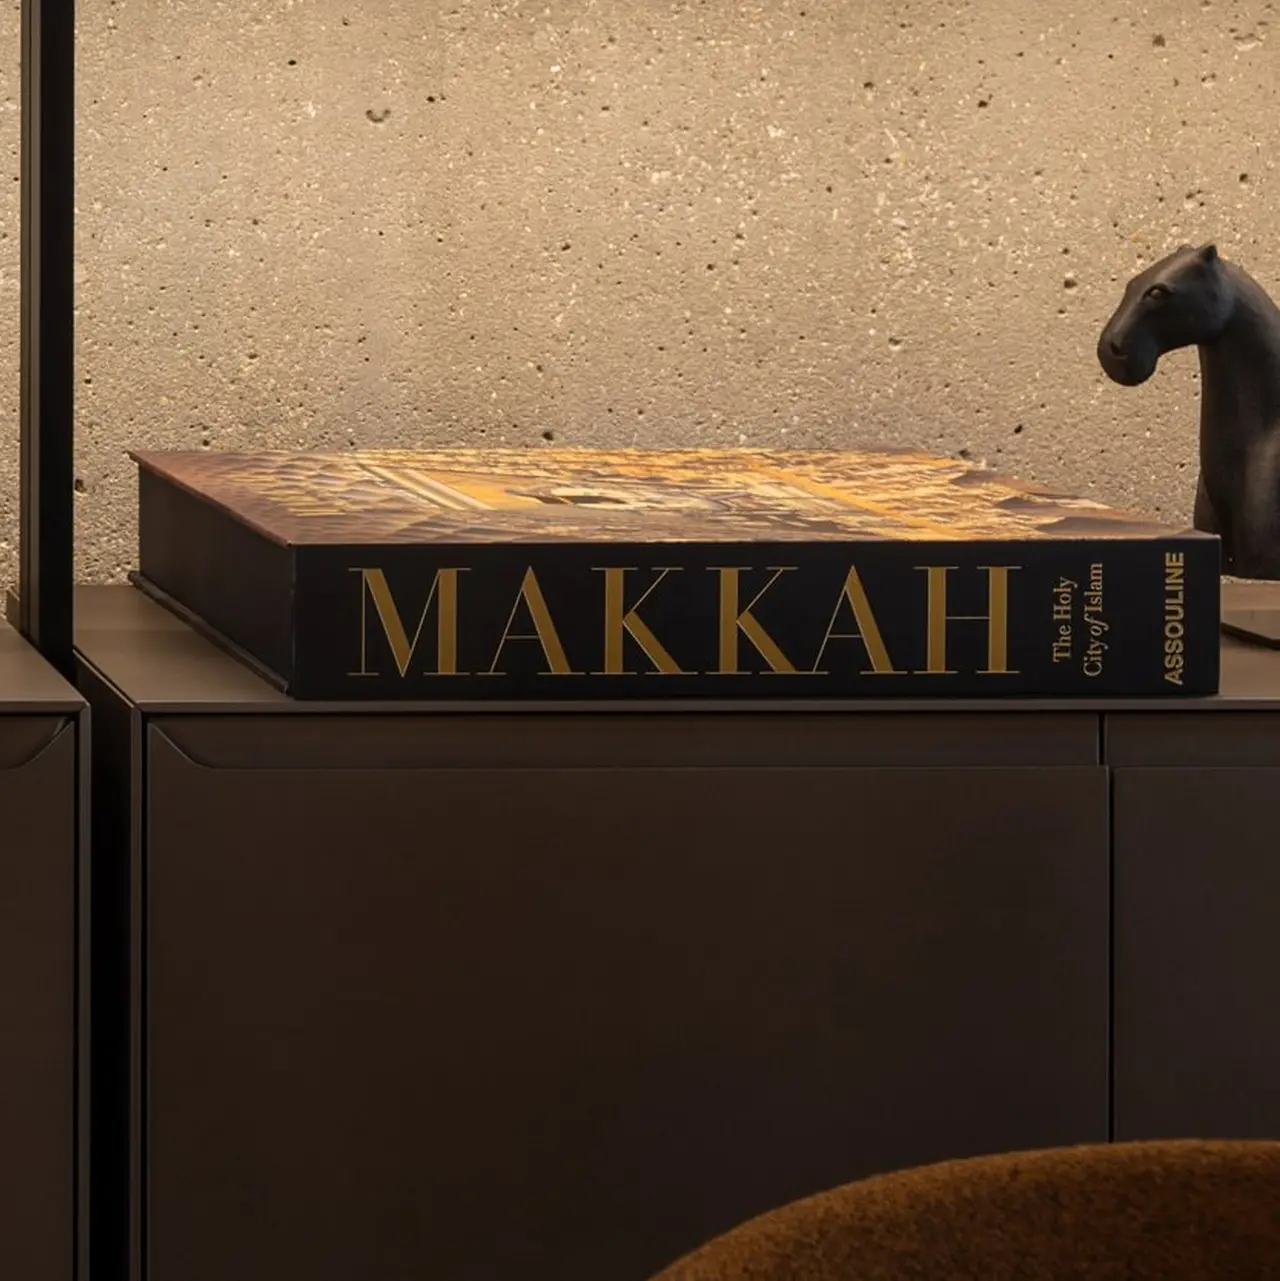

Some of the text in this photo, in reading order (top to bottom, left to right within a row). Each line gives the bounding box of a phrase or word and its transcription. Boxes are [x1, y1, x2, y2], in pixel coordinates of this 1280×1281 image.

[347, 565, 1023, 678] MAKKAH
[1052, 576, 1078, 663] The Holy
[1082, 562, 1109, 677] City of Islam
[1164, 551, 1185, 686] ASSOULINE
